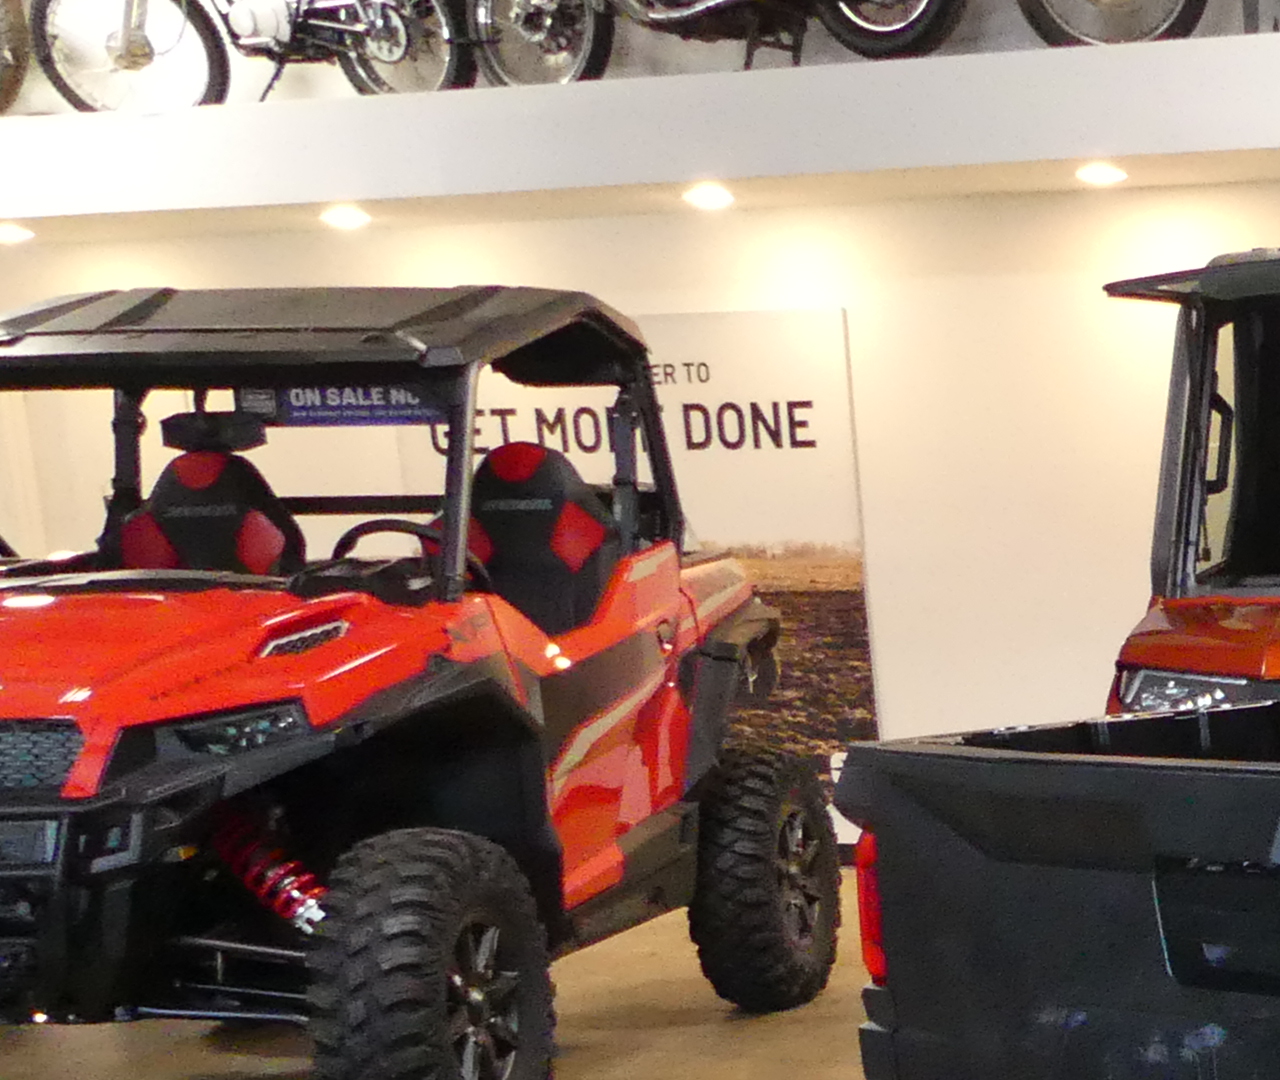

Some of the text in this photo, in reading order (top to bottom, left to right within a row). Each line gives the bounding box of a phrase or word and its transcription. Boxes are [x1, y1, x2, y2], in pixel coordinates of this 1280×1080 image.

[682, 362, 710, 383] TO
[290, 387, 321, 407] ON
[326, 387, 386, 406] SALE
[682, 401, 817, 450] DONE
